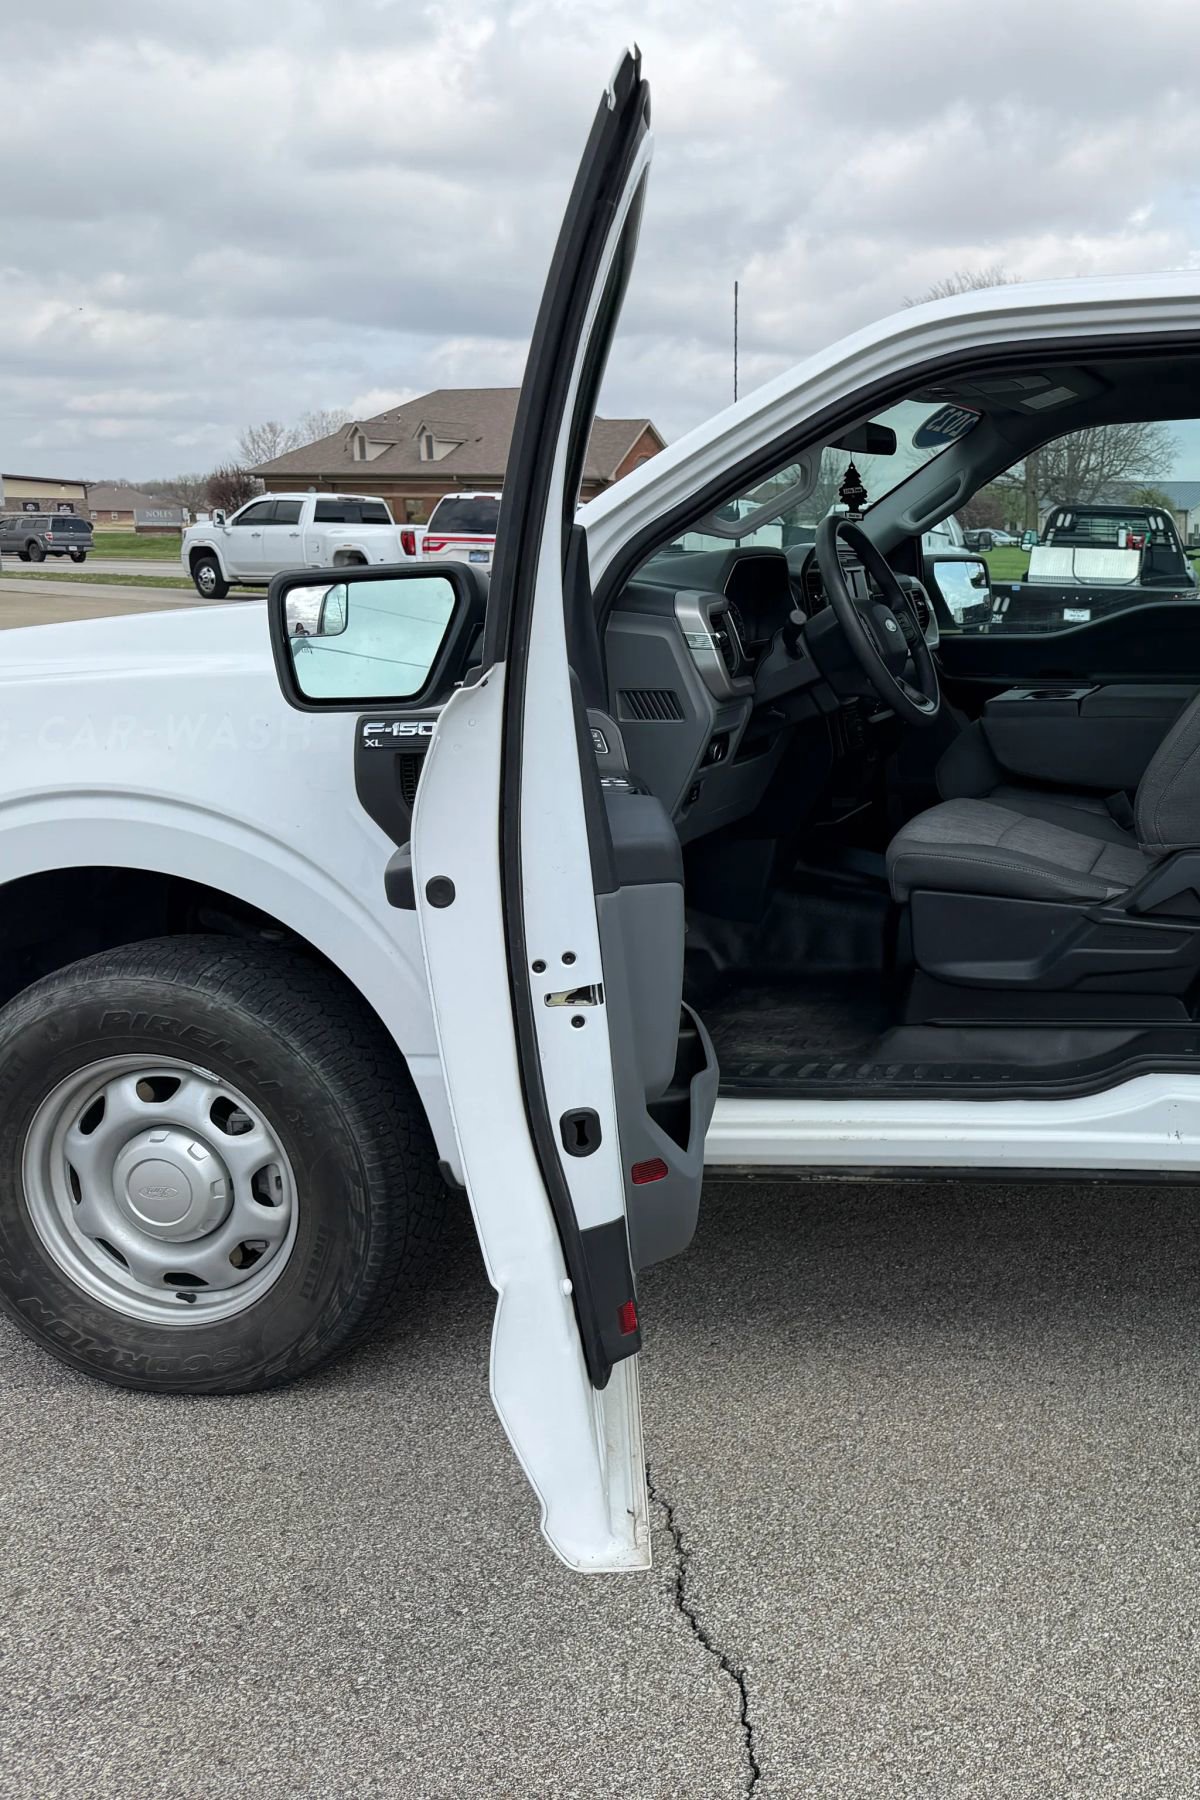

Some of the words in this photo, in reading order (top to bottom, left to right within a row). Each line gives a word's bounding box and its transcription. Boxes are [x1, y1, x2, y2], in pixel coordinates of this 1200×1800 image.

[363, 721, 436, 736] F-150
[364, 739, 383, 747] XL
[99, 1008, 284, 1089] PIRELLI
[17, 1297, 242, 1374] SCORPION
